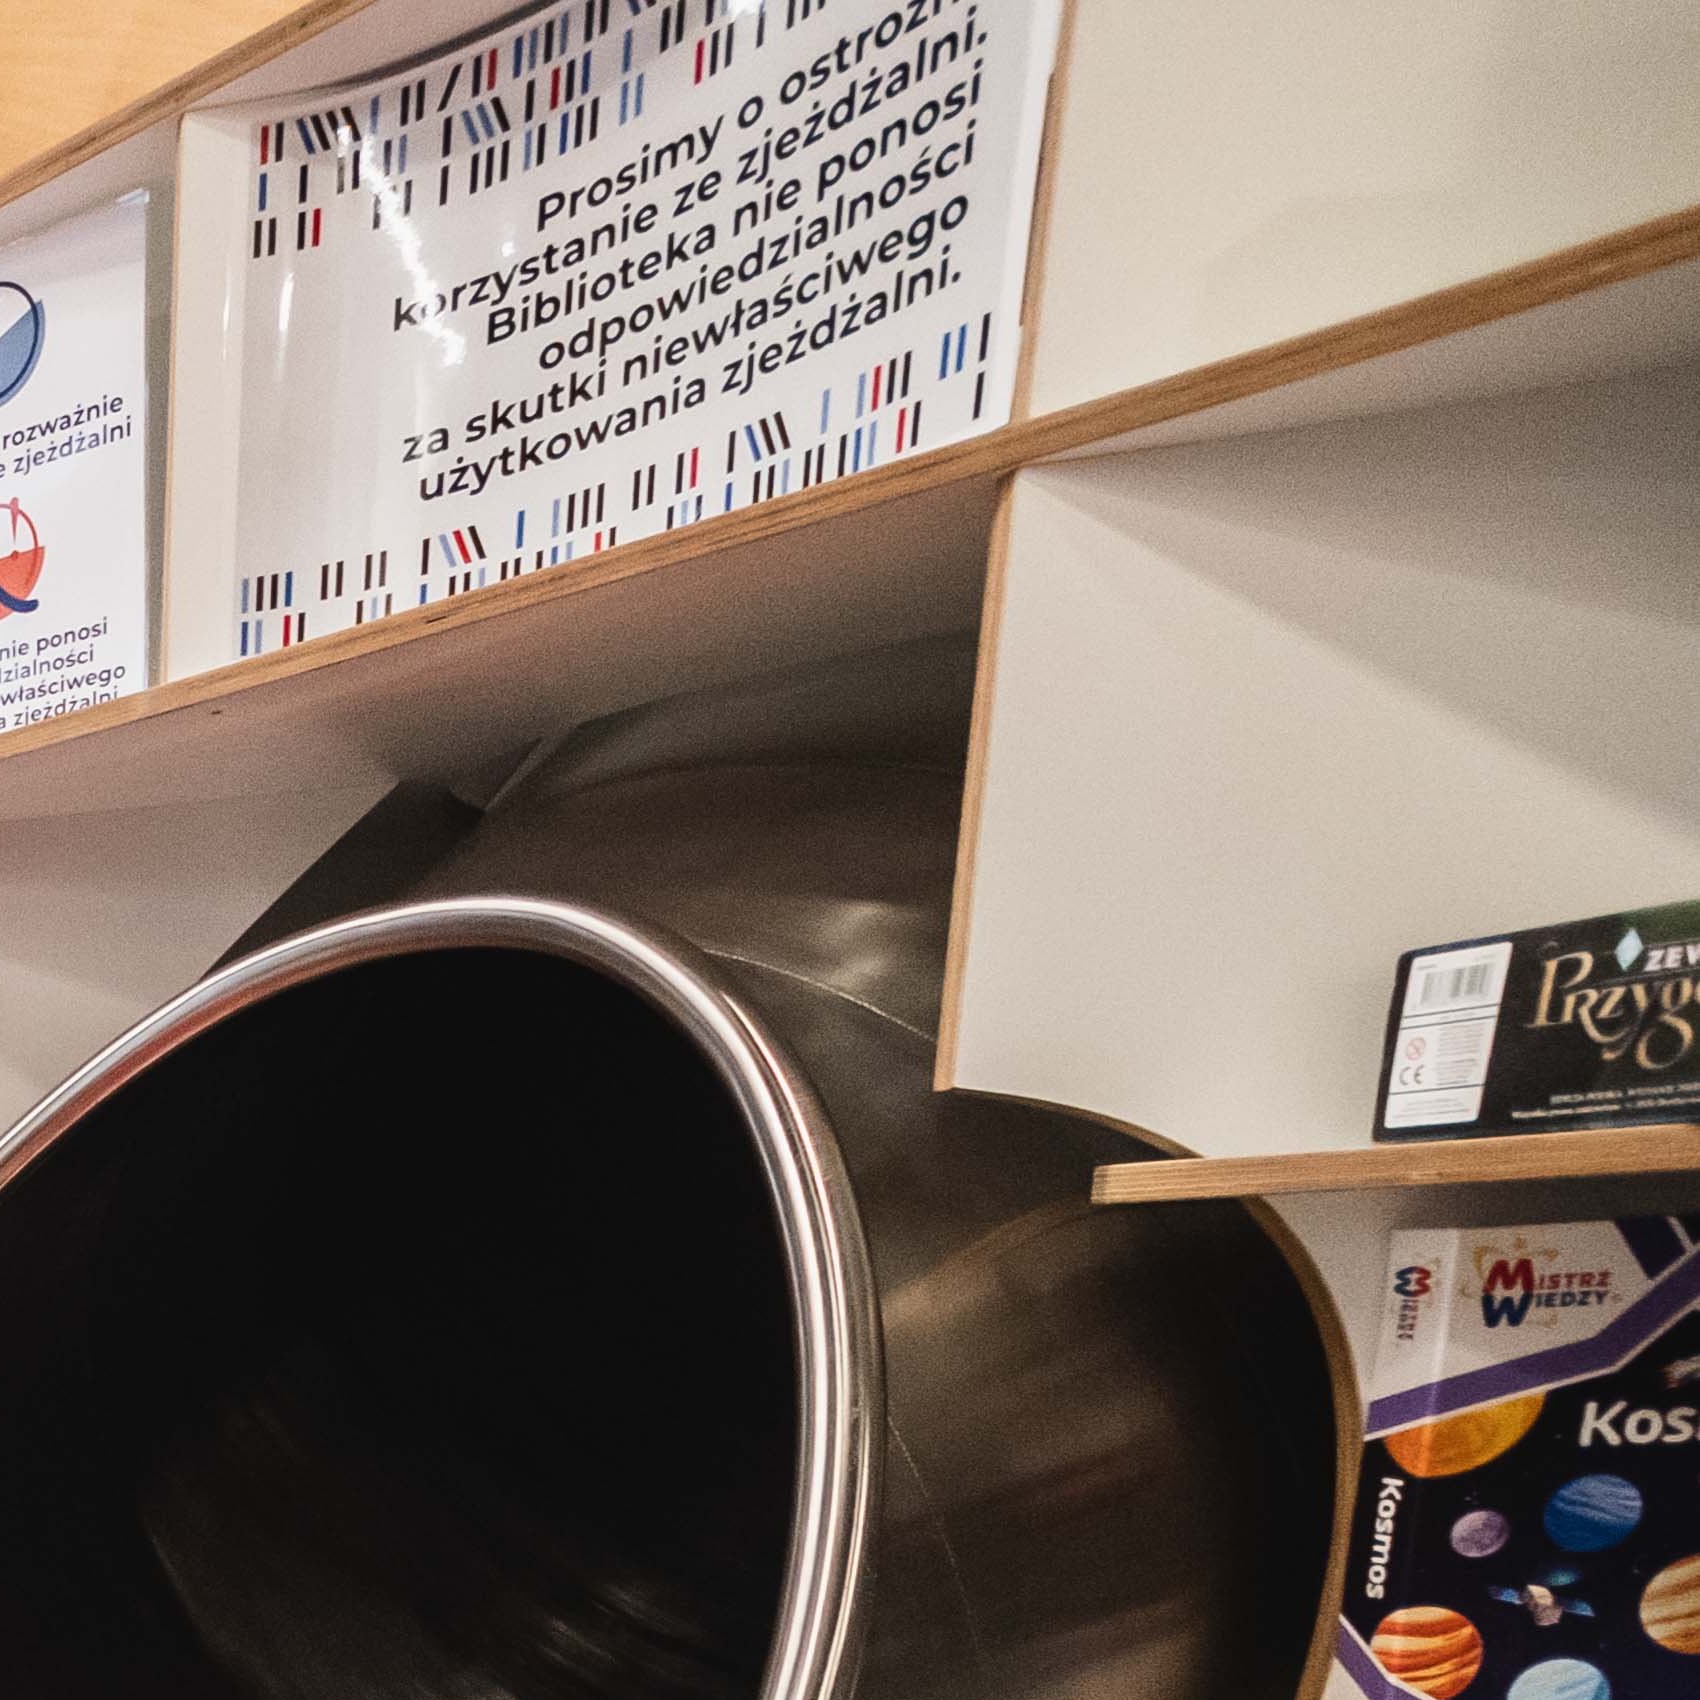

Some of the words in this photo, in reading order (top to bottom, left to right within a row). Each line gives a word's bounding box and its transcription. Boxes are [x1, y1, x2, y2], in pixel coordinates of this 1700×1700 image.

[393, 203, 658, 331] korzystanie
[672, 170, 722, 218] ze
[736, 5, 987, 185] zjeżdżalni.
[486, 223, 715, 345] Biblioteka
[732, 179, 801, 237] nie
[817, 58, 983, 202] ponosi
[537, 114, 723, 232] Prosimy
[738, 96, 763, 129] o
[540, 119, 976, 369] odpowiedzialności
[402, 427, 449, 462] za
[465, 358, 607, 443] skutki
[622, 195, 968, 386] niewłaściwego
[419, 376, 706, 501] użytkowania
[721, 244, 961, 396] zjeżdżalni.
[2, 395, 123, 450] rozważnie
[14, 416, 132, 476] zjeżdżalni
[0, 640, 30, 661] nie
[36, 617, 108, 655] ponosi
[1579, 1400, 1700, 1447] Kos
[1366, 1477, 1404, 1600] Kosmos
